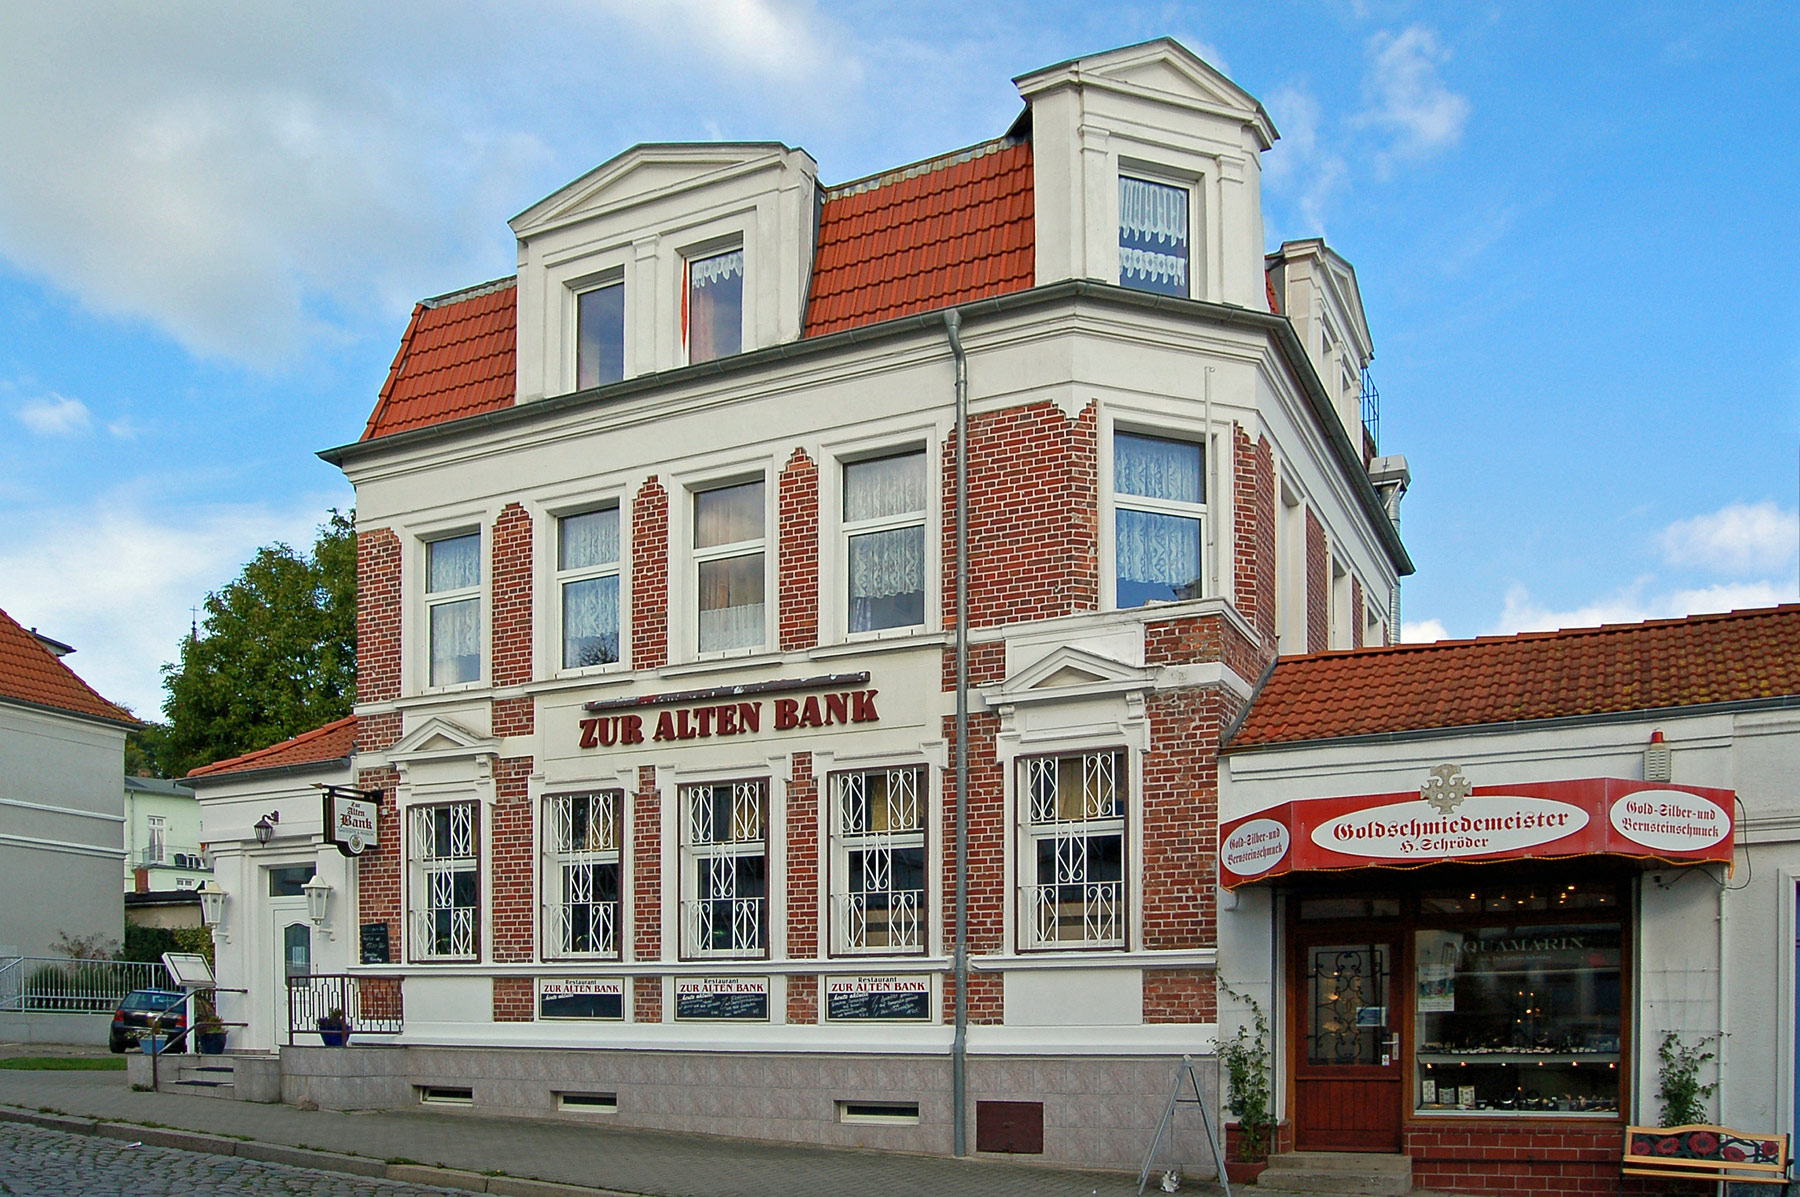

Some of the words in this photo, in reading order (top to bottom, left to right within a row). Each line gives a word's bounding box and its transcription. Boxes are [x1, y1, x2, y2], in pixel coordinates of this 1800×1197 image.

[579, 714, 645, 748] ZUR
[652, 702, 762, 742] ALTEN
[774, 689, 880, 731] BANK
[347, 807, 365, 817] Alten
[340, 813, 372, 830] Bank
[1333, 811, 1569, 842] Goldschmiedemeister
[1622, 817, 1719, 838] Bernsteinschmuck
[1227, 841, 1283, 866] Bernsteinschmuck
[1453, 936, 1584, 954] AQUAMARIN
[544, 984, 561, 992] ZUR
[564, 984, 592, 992] ALTEN
[594, 984, 619, 992] BANK
[680, 984, 700, 992] ZUR
[702, 984, 733, 992] ALTEN
[736, 983, 764, 992] BANK
[831, 983, 853, 991] ZUR
[856, 983, 890, 991] ALTEN
[894, 982, 925, 991] BANK
